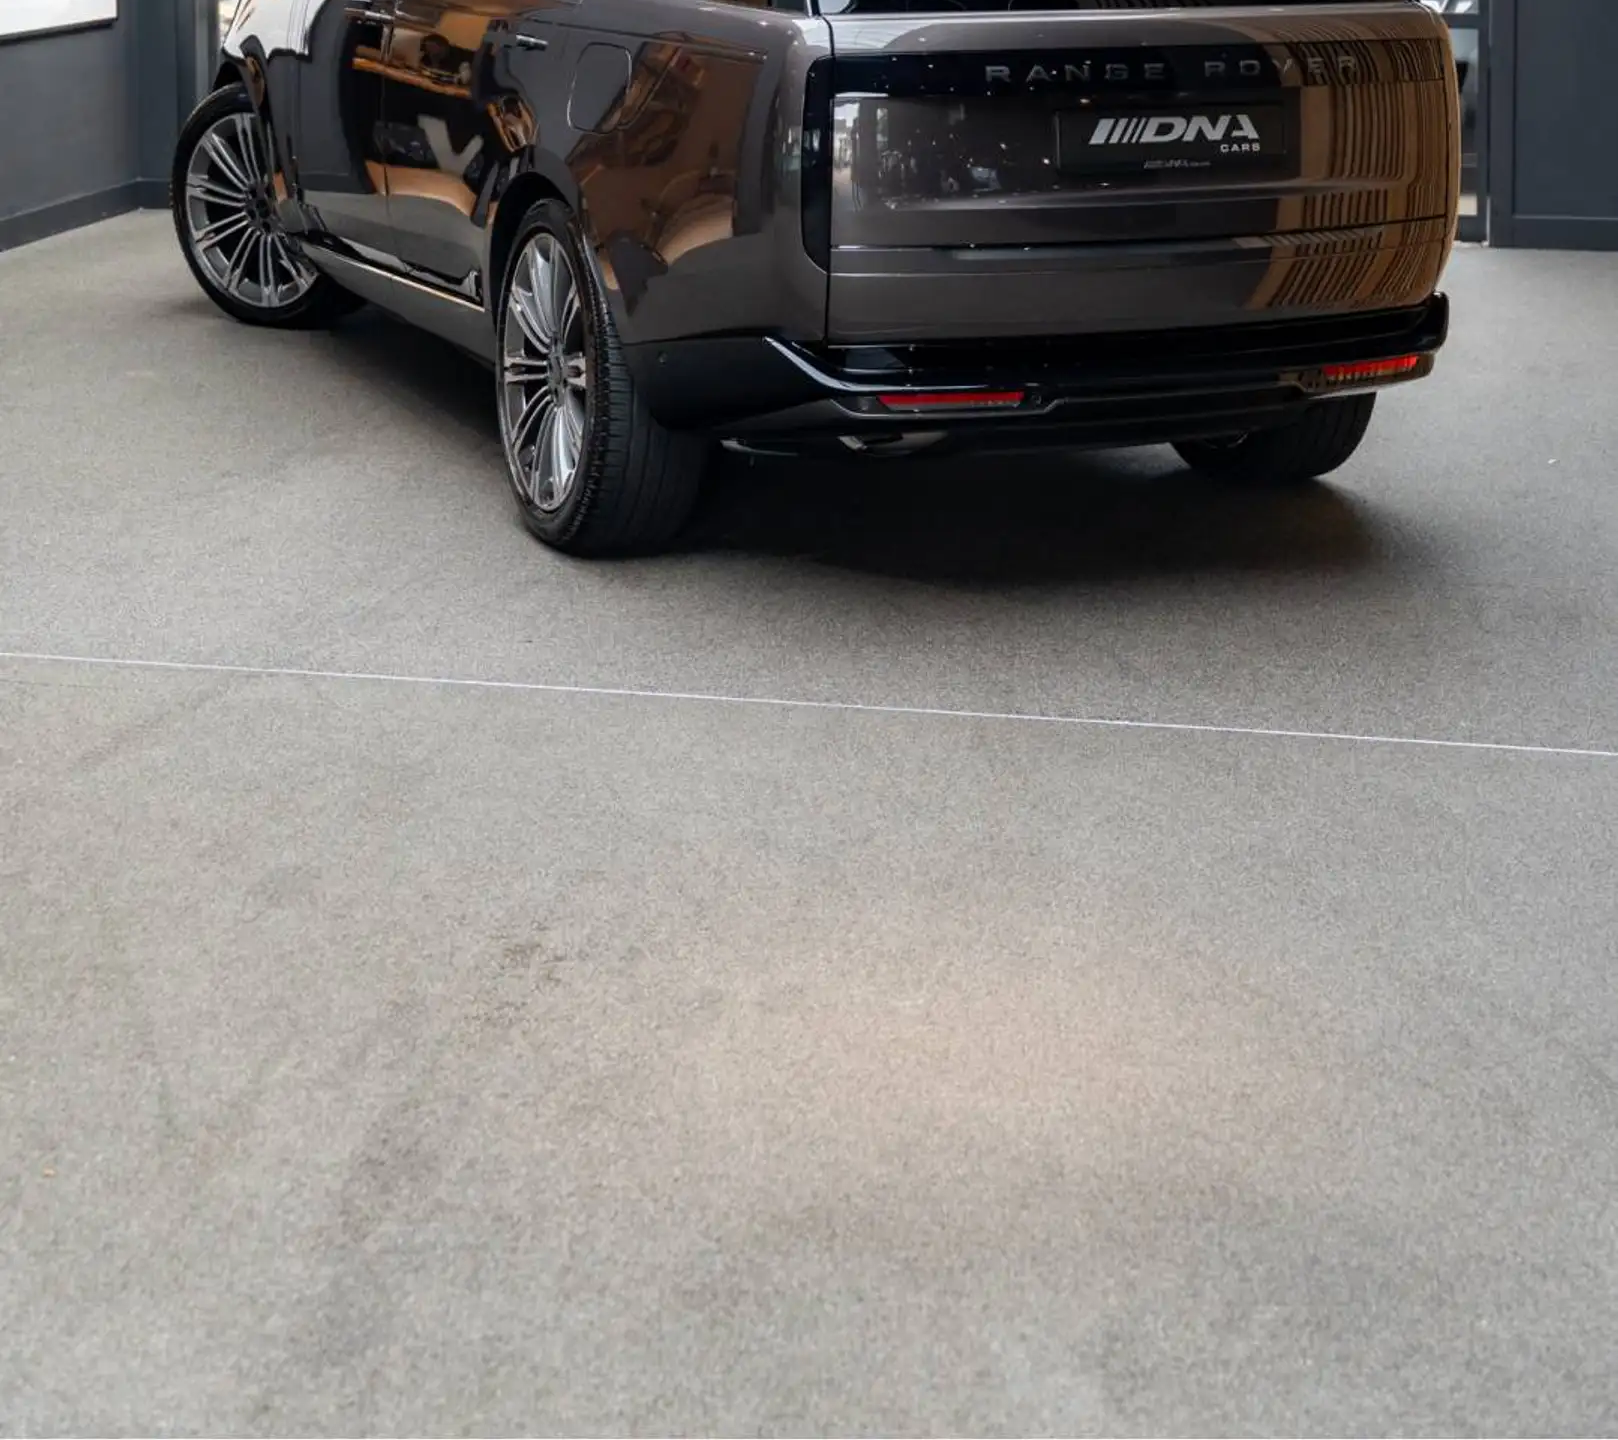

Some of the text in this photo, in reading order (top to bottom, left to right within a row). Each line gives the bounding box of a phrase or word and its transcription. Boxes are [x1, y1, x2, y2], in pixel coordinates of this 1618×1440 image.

[985, 55, 1357, 82] RANGE ROVER
[1139, 114, 1260, 143] DNA
[1220, 143, 1261, 153] CARS
